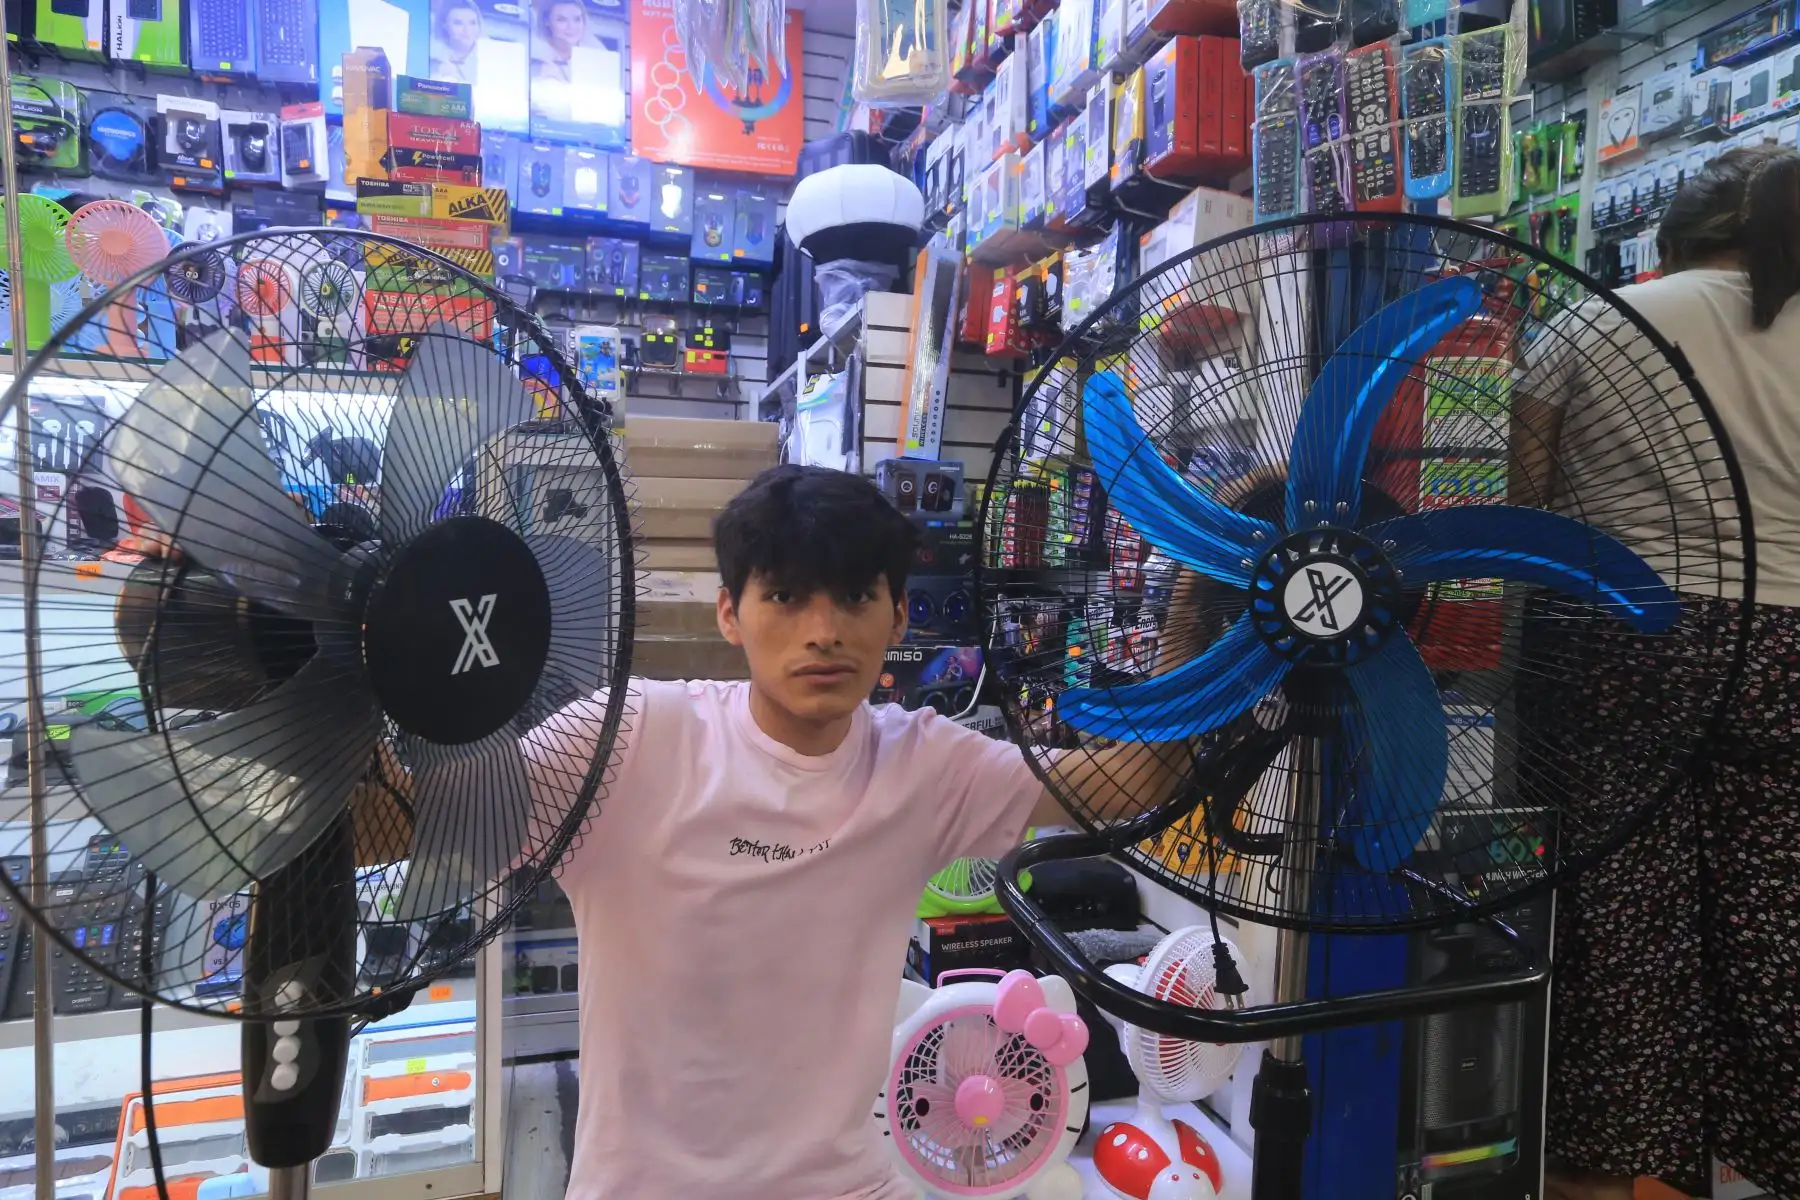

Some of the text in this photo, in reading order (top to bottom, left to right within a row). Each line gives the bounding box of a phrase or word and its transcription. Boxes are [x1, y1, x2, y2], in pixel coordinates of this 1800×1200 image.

[417, 82, 451, 92] Panasonic
[422, 152, 455, 161] Powercell
[361, 180, 390, 188] TOSHIBA
[448, 192, 487, 216] ALKA
[376, 215, 409, 224] TOSHIBA
[884, 650, 923, 661] IMISO
[941, 936, 1013, 951] WIRELESS SPEAKER
